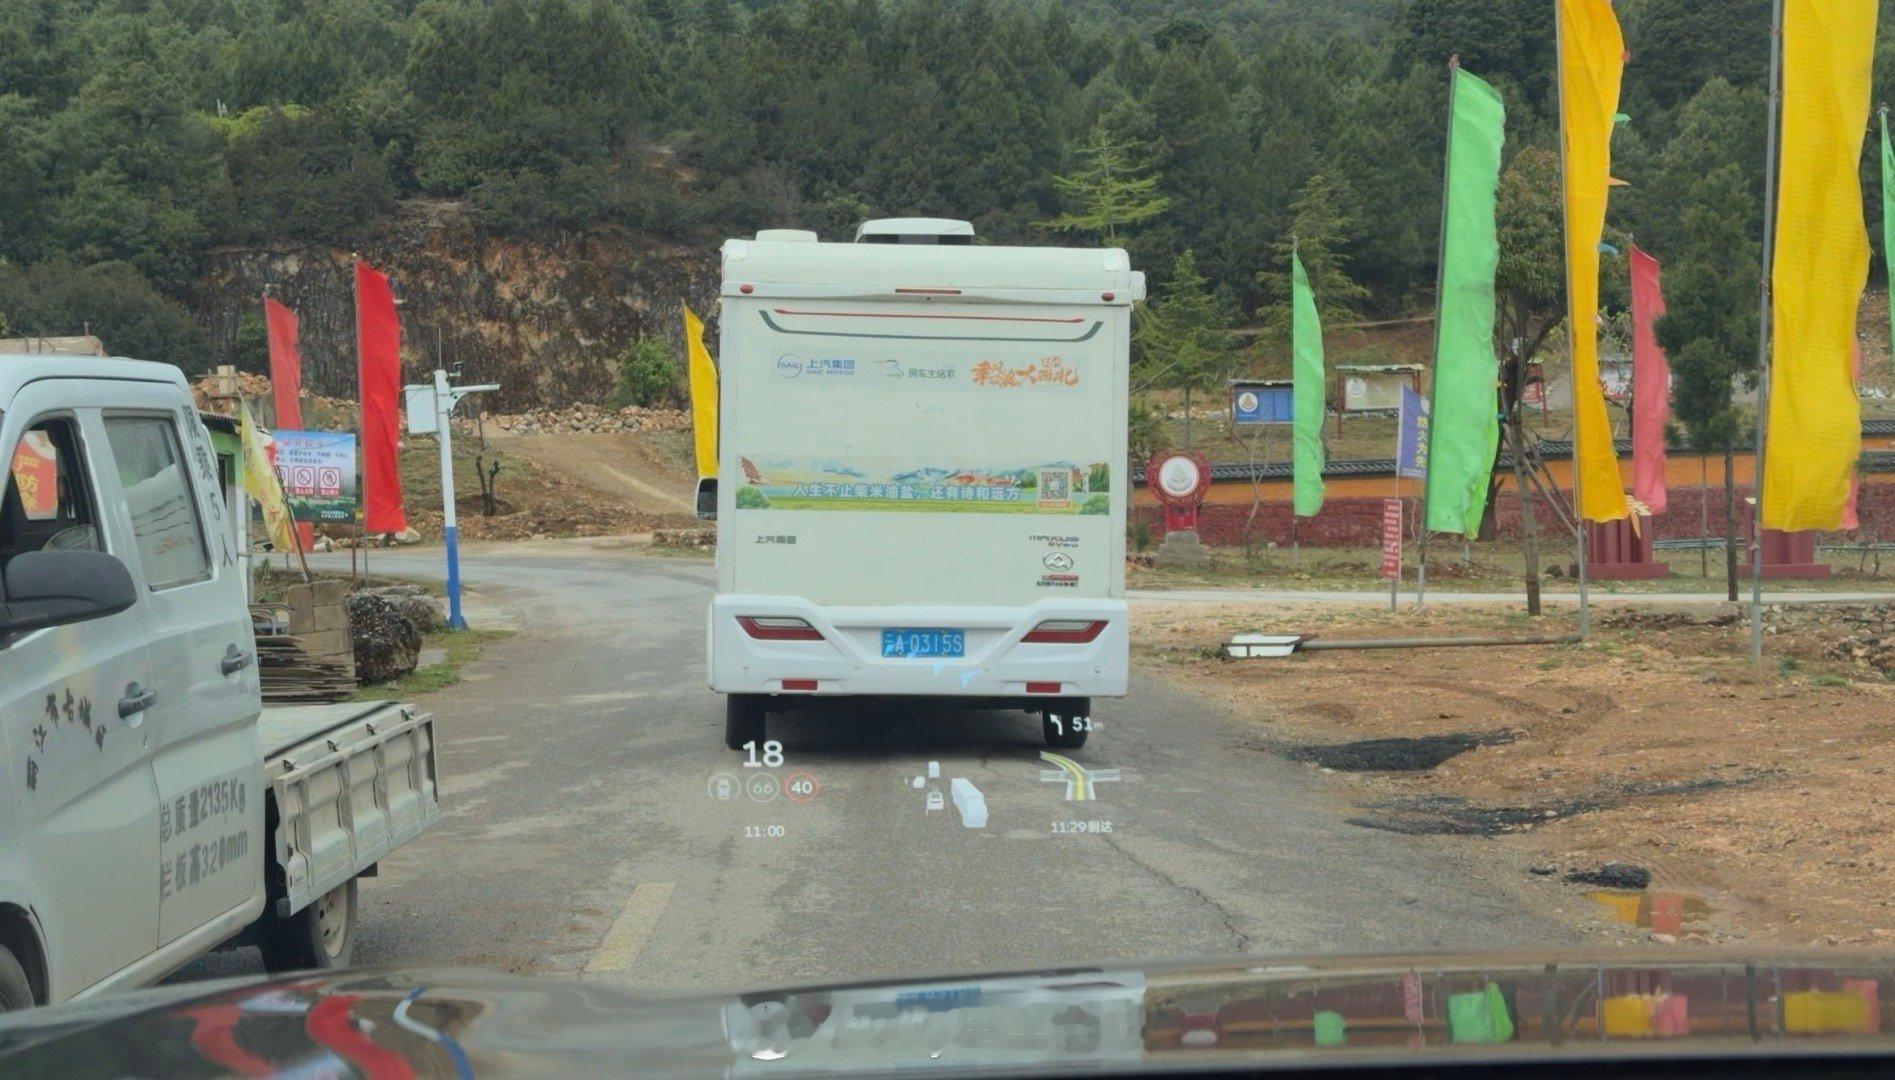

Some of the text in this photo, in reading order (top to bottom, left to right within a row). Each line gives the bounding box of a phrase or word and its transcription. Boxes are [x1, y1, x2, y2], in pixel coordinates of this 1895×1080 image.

[806, 358, 855, 369] 上汽集团
[742, 740, 784, 767] 18
[753, 782, 774, 794] 66
[791, 781, 812, 793] 40
[744, 825, 785, 837] 11:00
